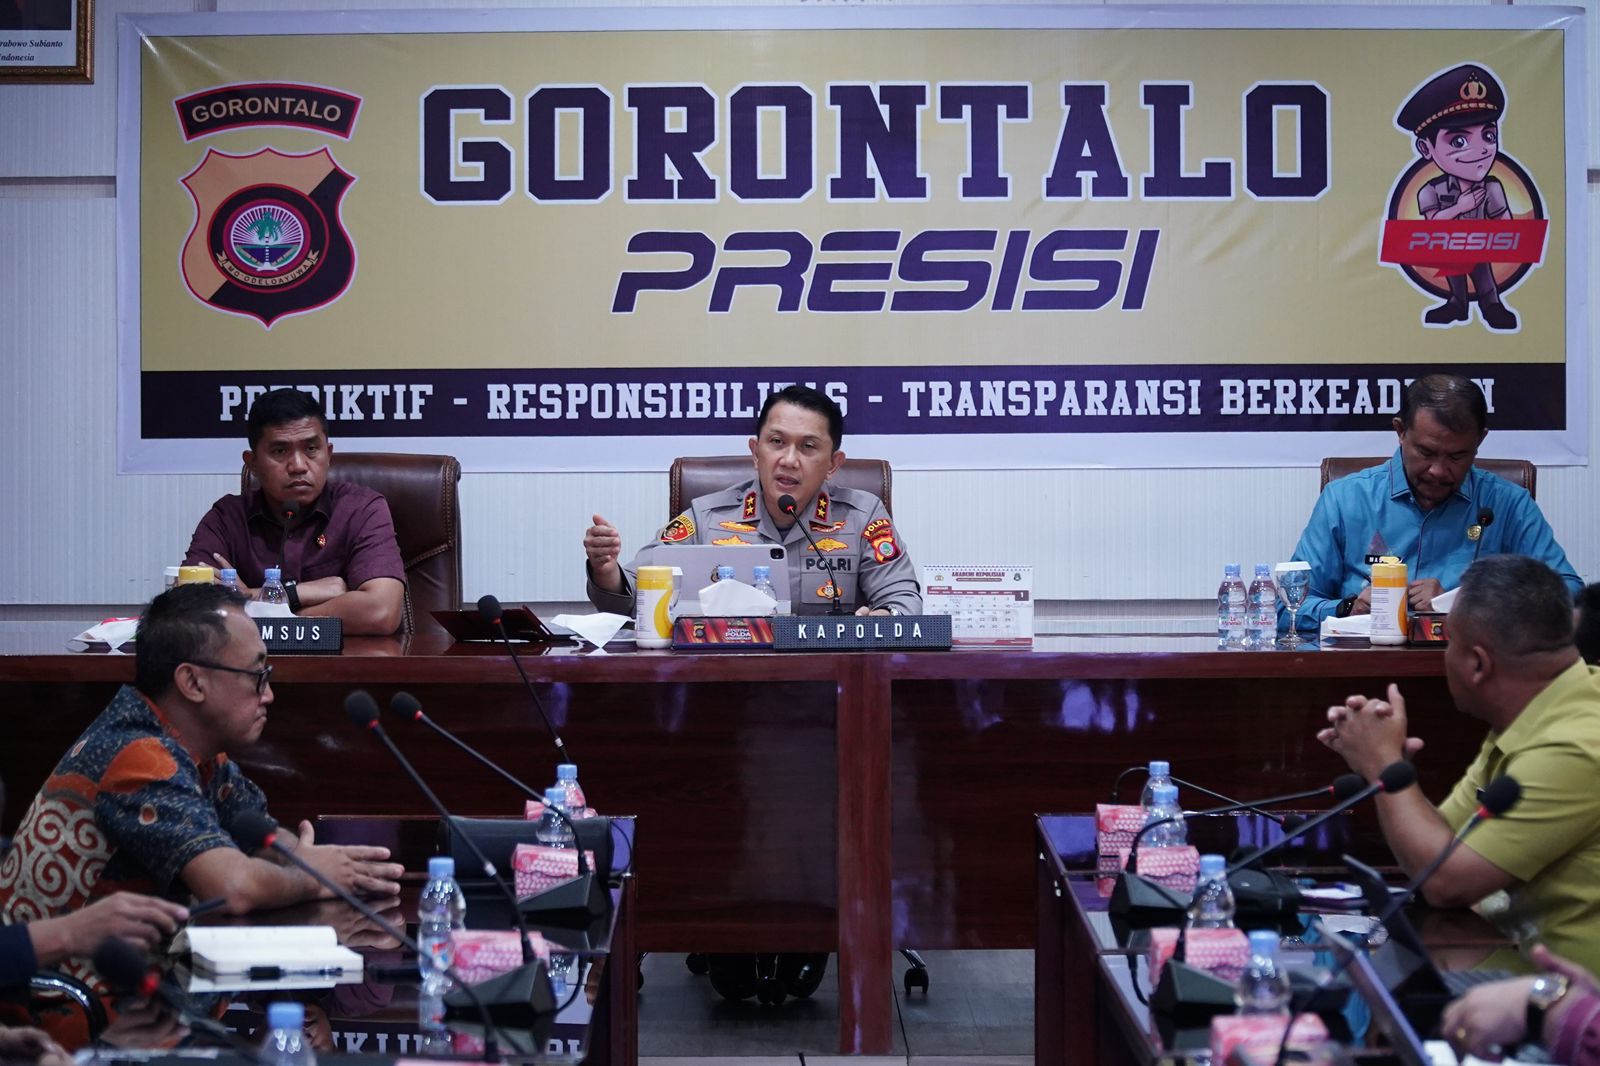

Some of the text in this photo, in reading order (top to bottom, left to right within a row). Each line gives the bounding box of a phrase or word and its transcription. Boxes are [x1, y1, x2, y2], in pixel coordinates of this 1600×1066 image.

[0, 40, 63, 48] rabowo Subianto
[191, 96, 342, 124] GORONTALO
[420, 82, 1330, 205] GORONTALO
[1408, 232, 1521, 251] PRESISI
[611, 229, 1160, 314] PRESISI
[219, 383, 434, 421] PIKTIF
[486, 381, 849, 420] RESPONSIBILIS
[902, 379, 1201, 418] TRANSPARANSI
[1219, 377, 1495, 416] BERKEADN
[864, 519, 890, 537] POLDA
[805, 557, 851, 571] POLRI
[262, 626, 320, 640] MSUS
[798, 623, 923, 639] KAPOLDA
